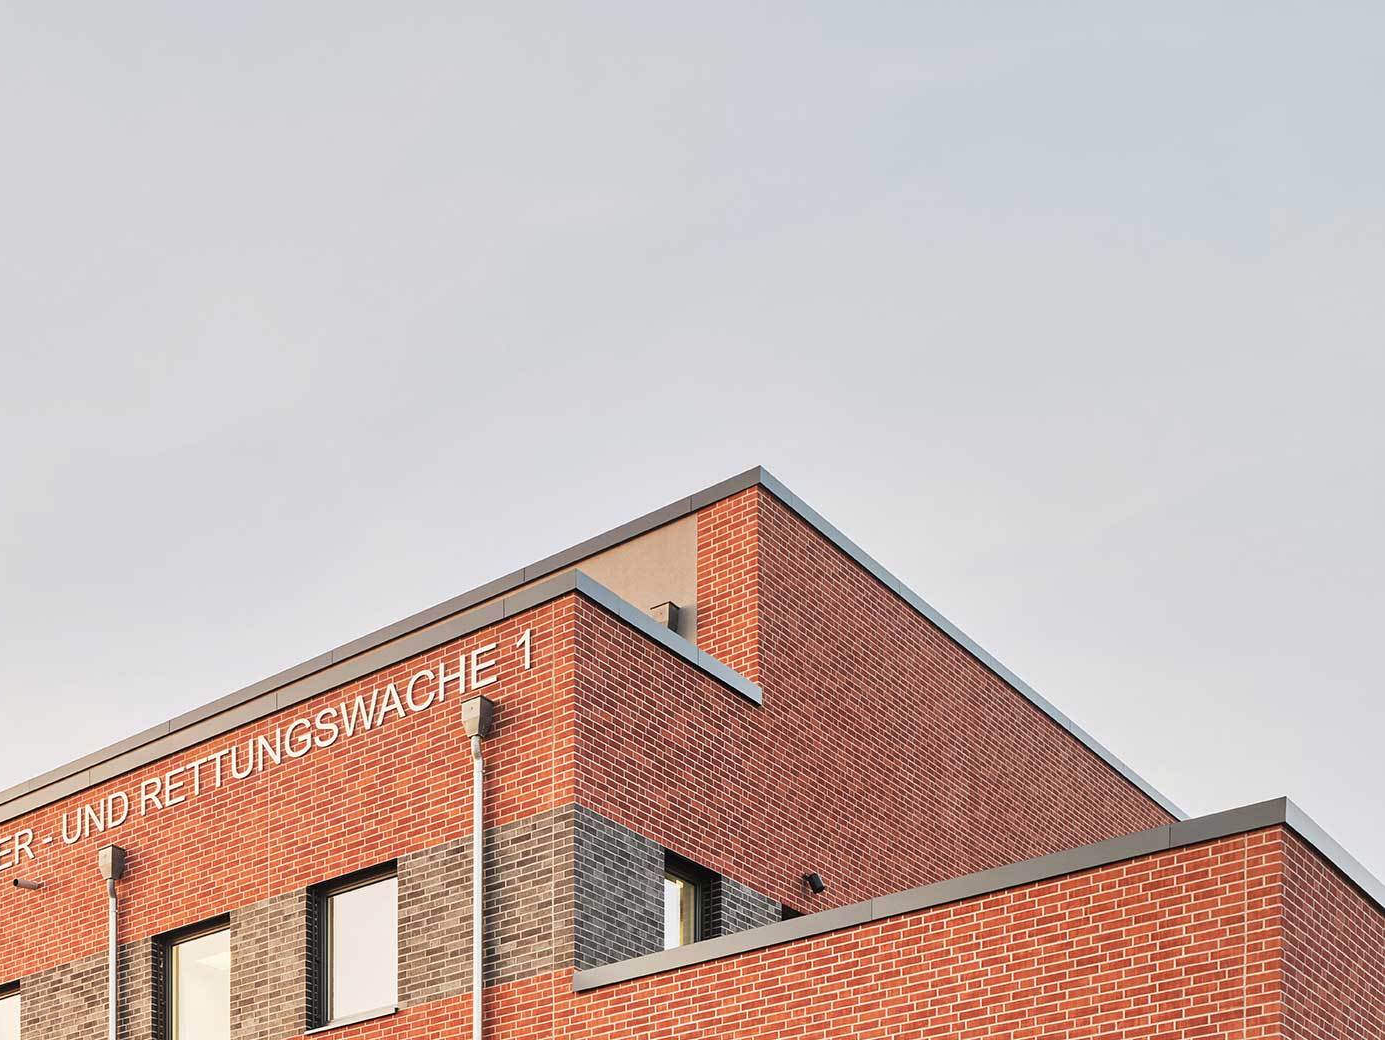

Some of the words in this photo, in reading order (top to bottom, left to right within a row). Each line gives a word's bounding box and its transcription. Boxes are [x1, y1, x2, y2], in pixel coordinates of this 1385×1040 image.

[62, 791, 129, 844] UND
[140, 642, 498, 817] RETTUNGSWACHE
[516, 628, 531, 670] 1
